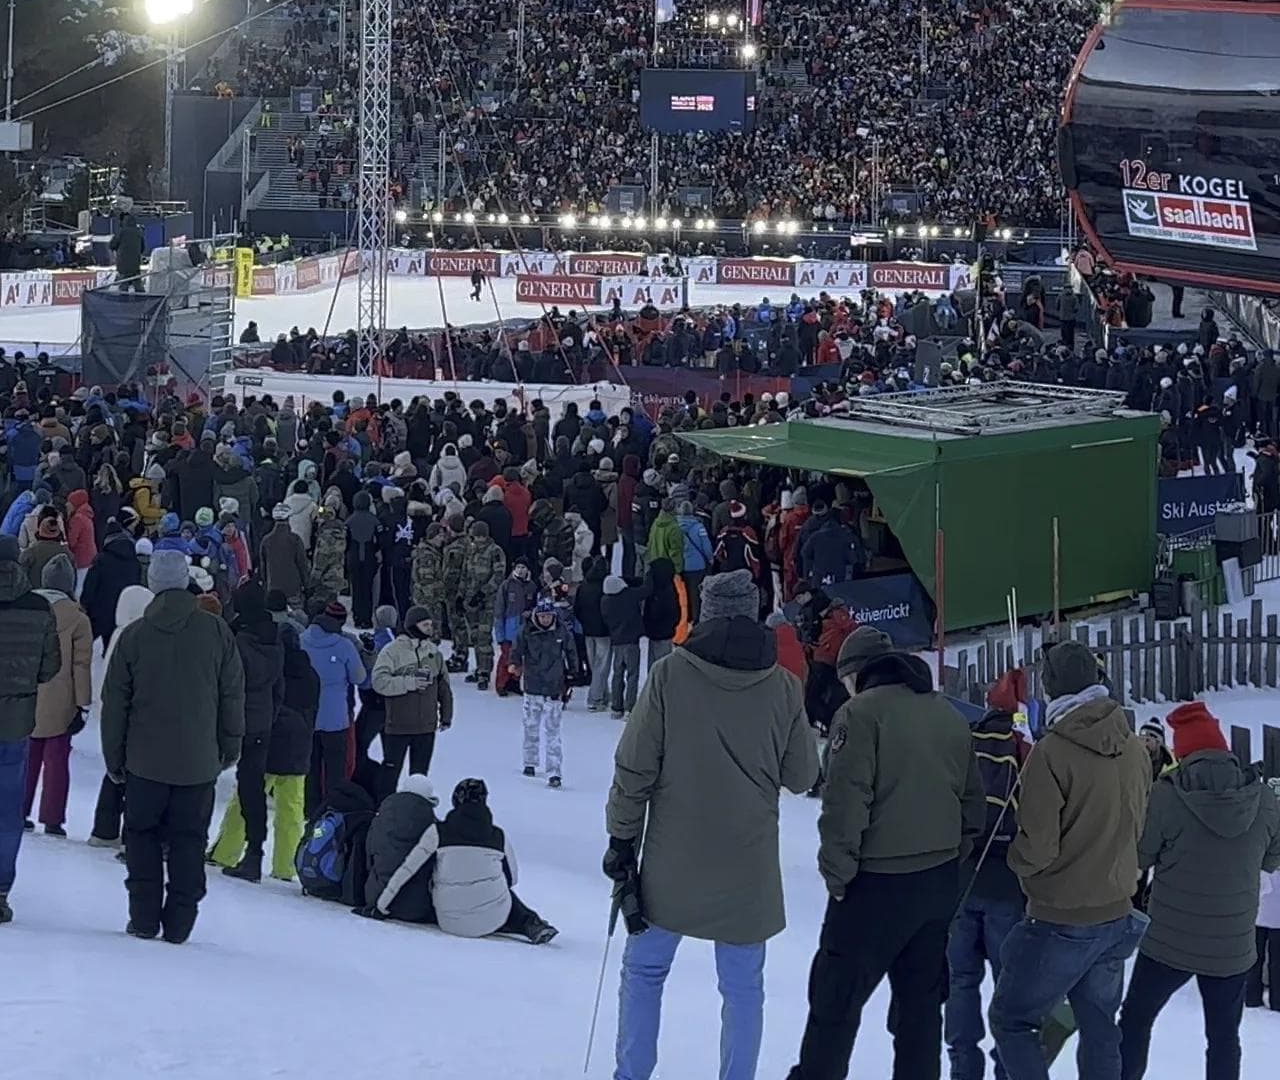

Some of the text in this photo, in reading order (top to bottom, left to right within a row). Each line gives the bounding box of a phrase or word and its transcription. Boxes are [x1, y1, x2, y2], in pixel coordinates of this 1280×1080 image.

[1119, 158, 1250, 200] 12er KOGEL
[1163, 199, 1245, 231] saalbach
[429, 257, 498, 272] GENERALI
[574, 260, 641, 274] GENERALI
[721, 264, 791, 283] GENERALI
[872, 268, 945, 286] GENERALI
[1162, 502, 1184, 519] Ski
